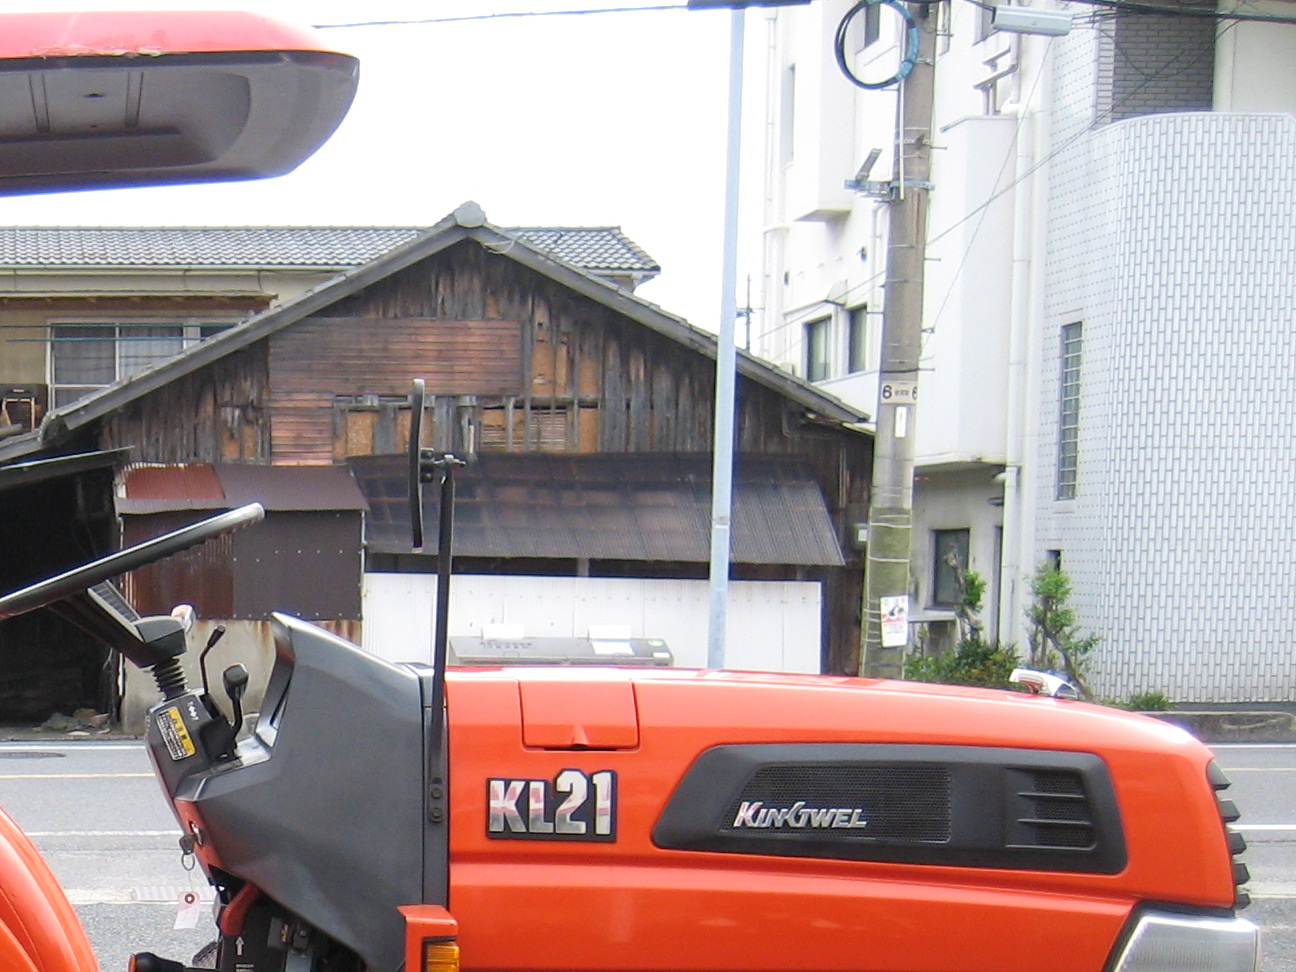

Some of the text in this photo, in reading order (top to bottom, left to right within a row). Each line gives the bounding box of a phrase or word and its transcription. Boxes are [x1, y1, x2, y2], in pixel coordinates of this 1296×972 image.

[883, 384, 892, 400] 6
[488, 770, 612, 836] KL21
[733, 801, 867, 828] KINGWEL
